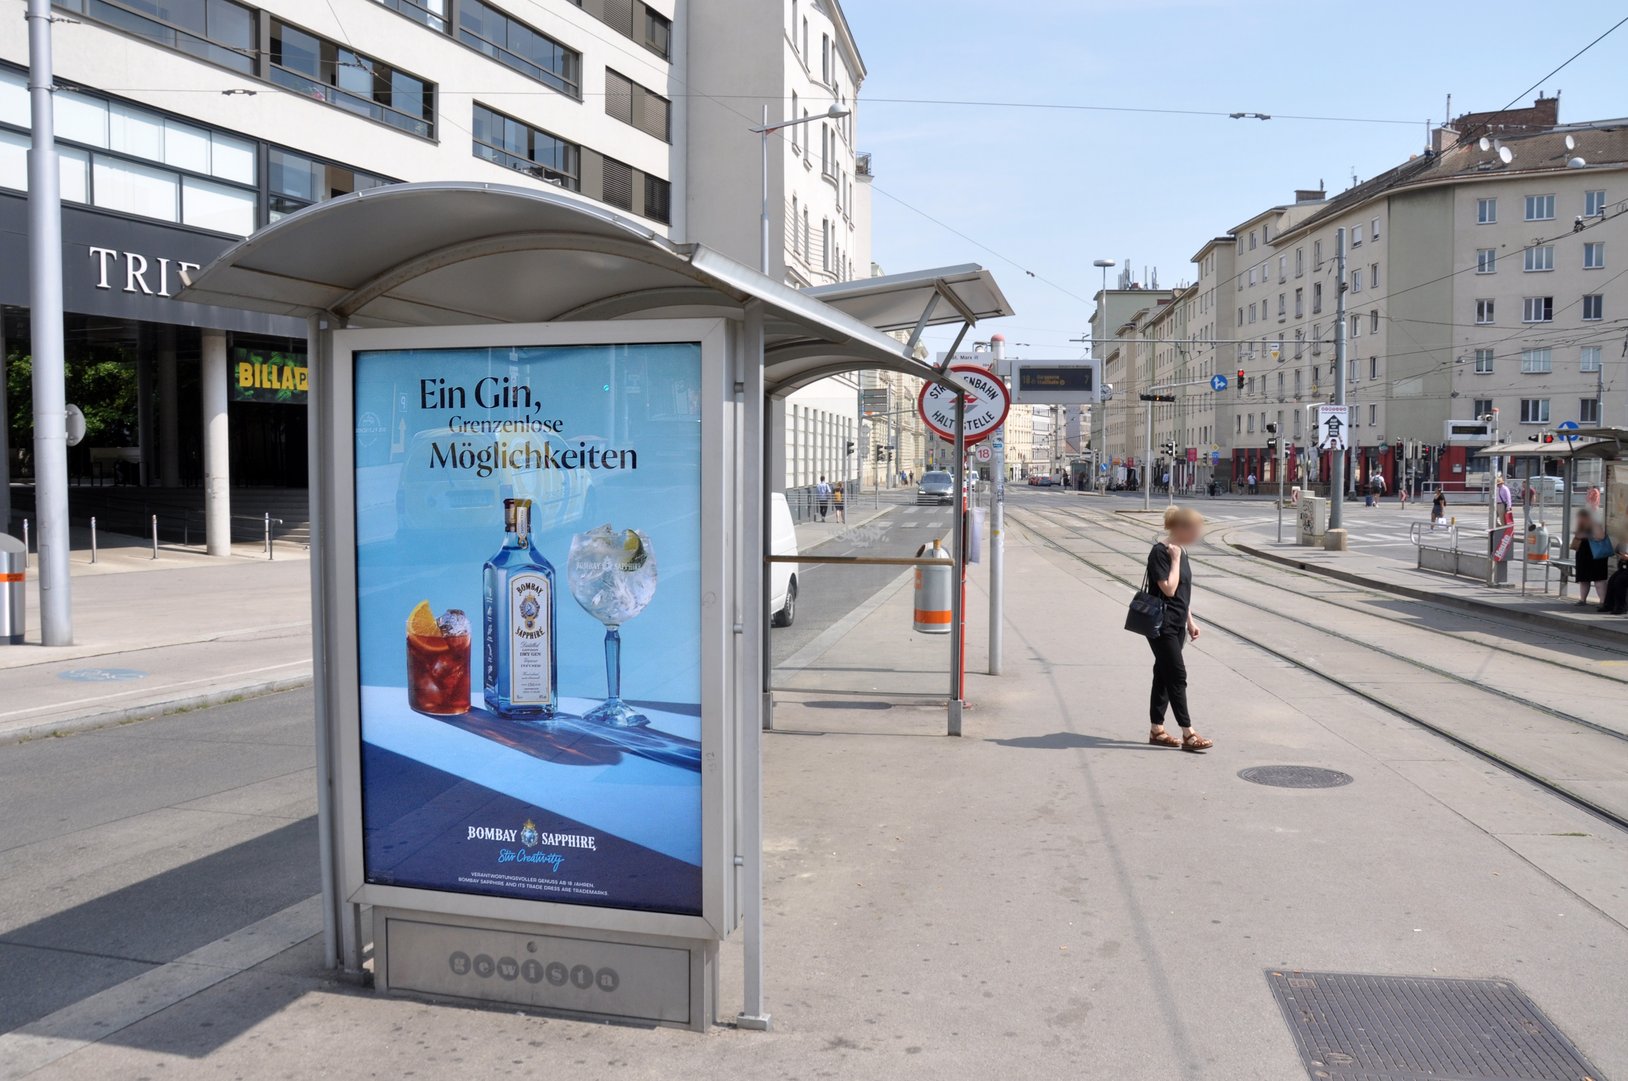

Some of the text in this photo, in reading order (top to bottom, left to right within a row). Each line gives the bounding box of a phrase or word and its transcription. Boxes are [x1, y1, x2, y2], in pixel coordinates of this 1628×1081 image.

[239, 362, 294, 390] BILLA
[930, 375, 999, 400] STRNBAHN
[420, 376, 542, 414] Ein Gin,
[449, 414, 564, 434] Grenzenlose
[932, 410, 995, 431] HALTTELLE
[429, 440, 638, 478] Möglichkeiten
[978, 449, 989, 458] 18
[516, 582, 543, 596] BOMBAY
[515, 626, 545, 640] SAPPHIRE
[467, 826, 597, 851] BOMBAY SAPPHIRE
[498, 848, 565, 872] Stir Creativity
[471, 872, 537, 882] VERANTWORTUNGSVOLLER
[538, 877, 558, 885] GENUSS
[451, 955, 617, 989] gewista
